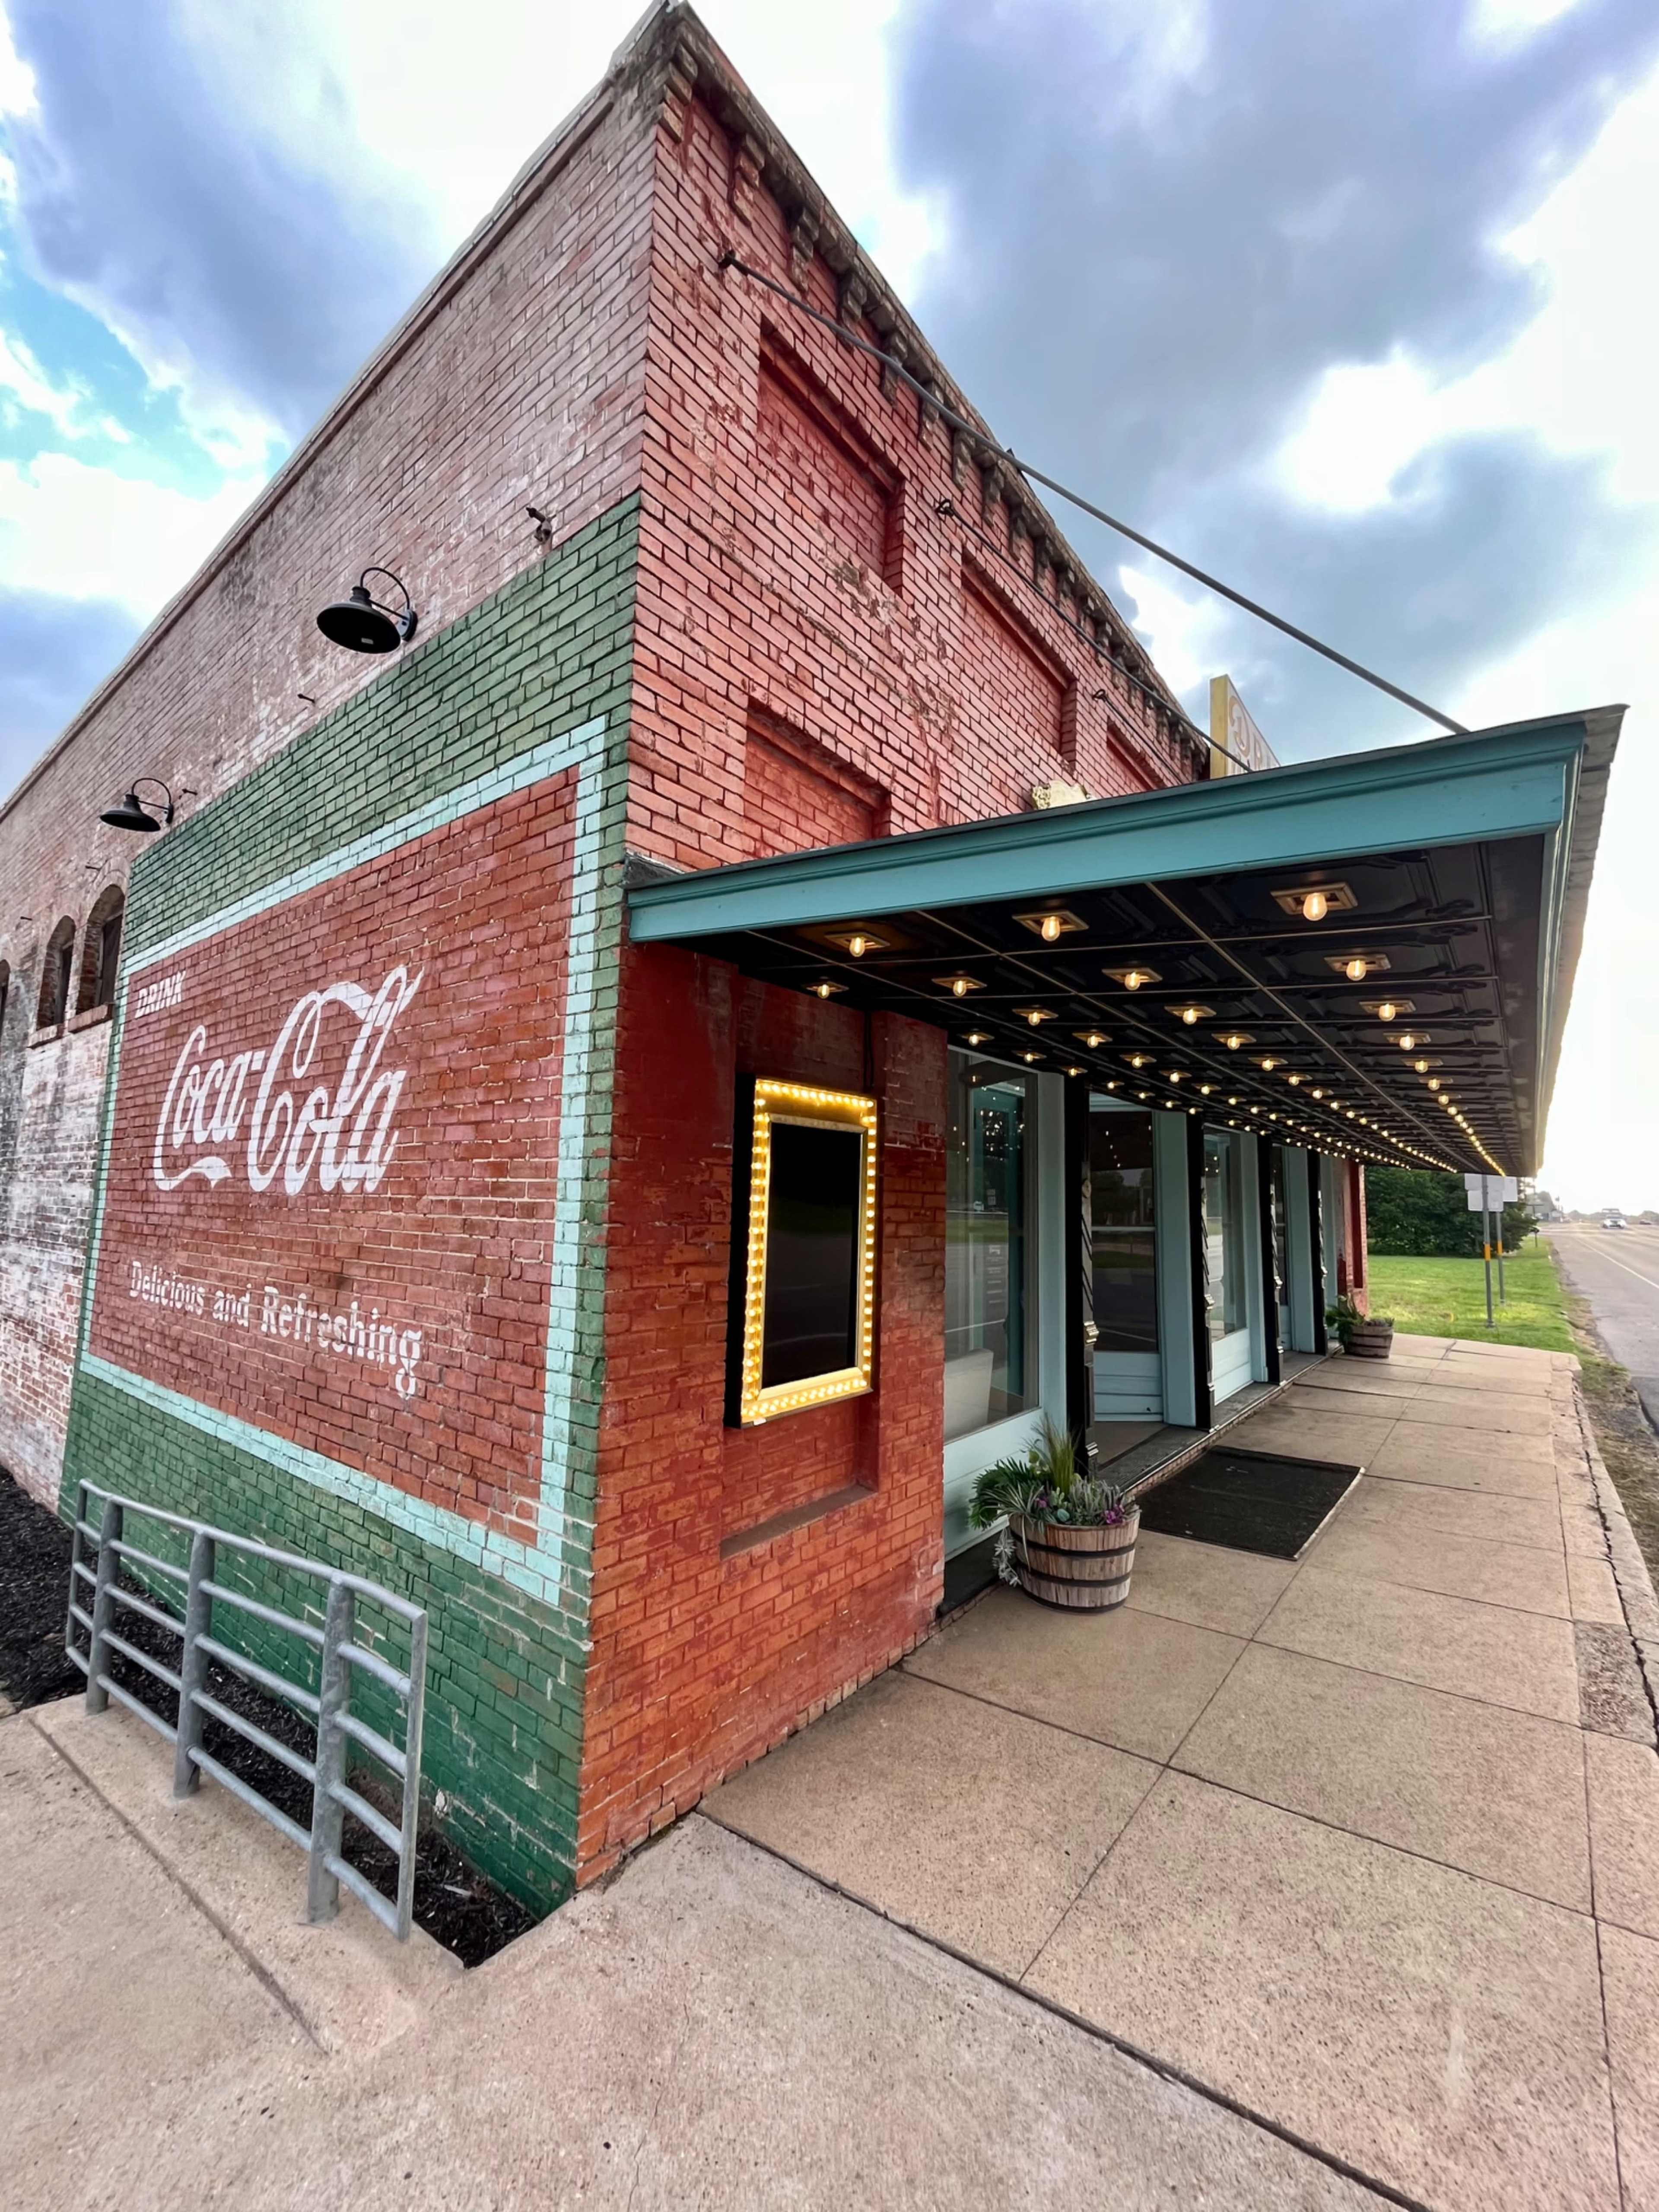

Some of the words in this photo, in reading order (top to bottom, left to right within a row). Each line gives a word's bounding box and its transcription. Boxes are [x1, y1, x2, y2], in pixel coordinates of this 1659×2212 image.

[134, 971, 186, 1019] DRINK
[153, 964, 425, 1196] Coca-Cola
[130, 1261, 205, 1315] Delicious
[213, 1283, 251, 1327] and
[261, 1286, 422, 1400] Refreshing
